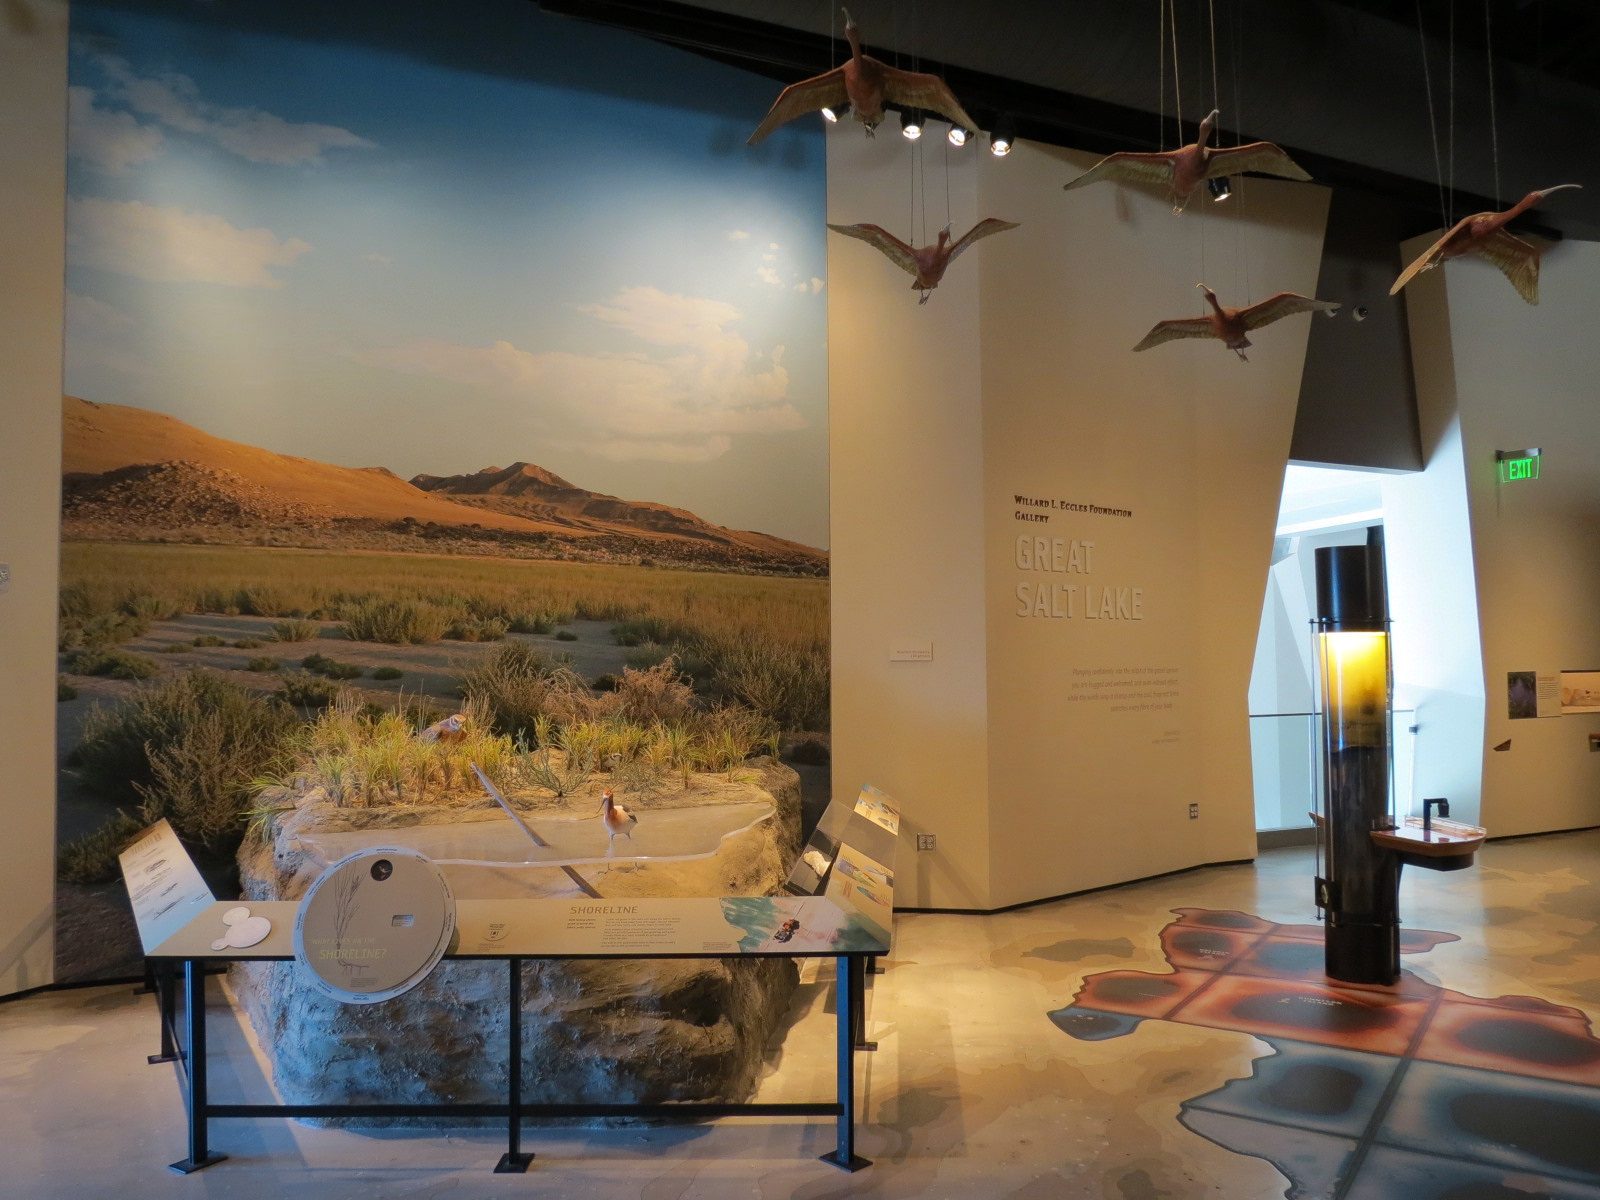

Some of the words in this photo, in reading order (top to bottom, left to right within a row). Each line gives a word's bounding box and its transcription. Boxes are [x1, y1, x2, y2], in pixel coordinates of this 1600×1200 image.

[1509, 458, 1533, 480] EXIT
[1051, 500, 1059, 509] L.
[1014, 535, 1096, 575] GREAT
[1015, 582, 1079, 619] SALT
[1084, 584, 1144, 621] LAKE
[570, 906, 638, 915] SHORELINE
[319, 948, 387, 960] SHORELINE?
